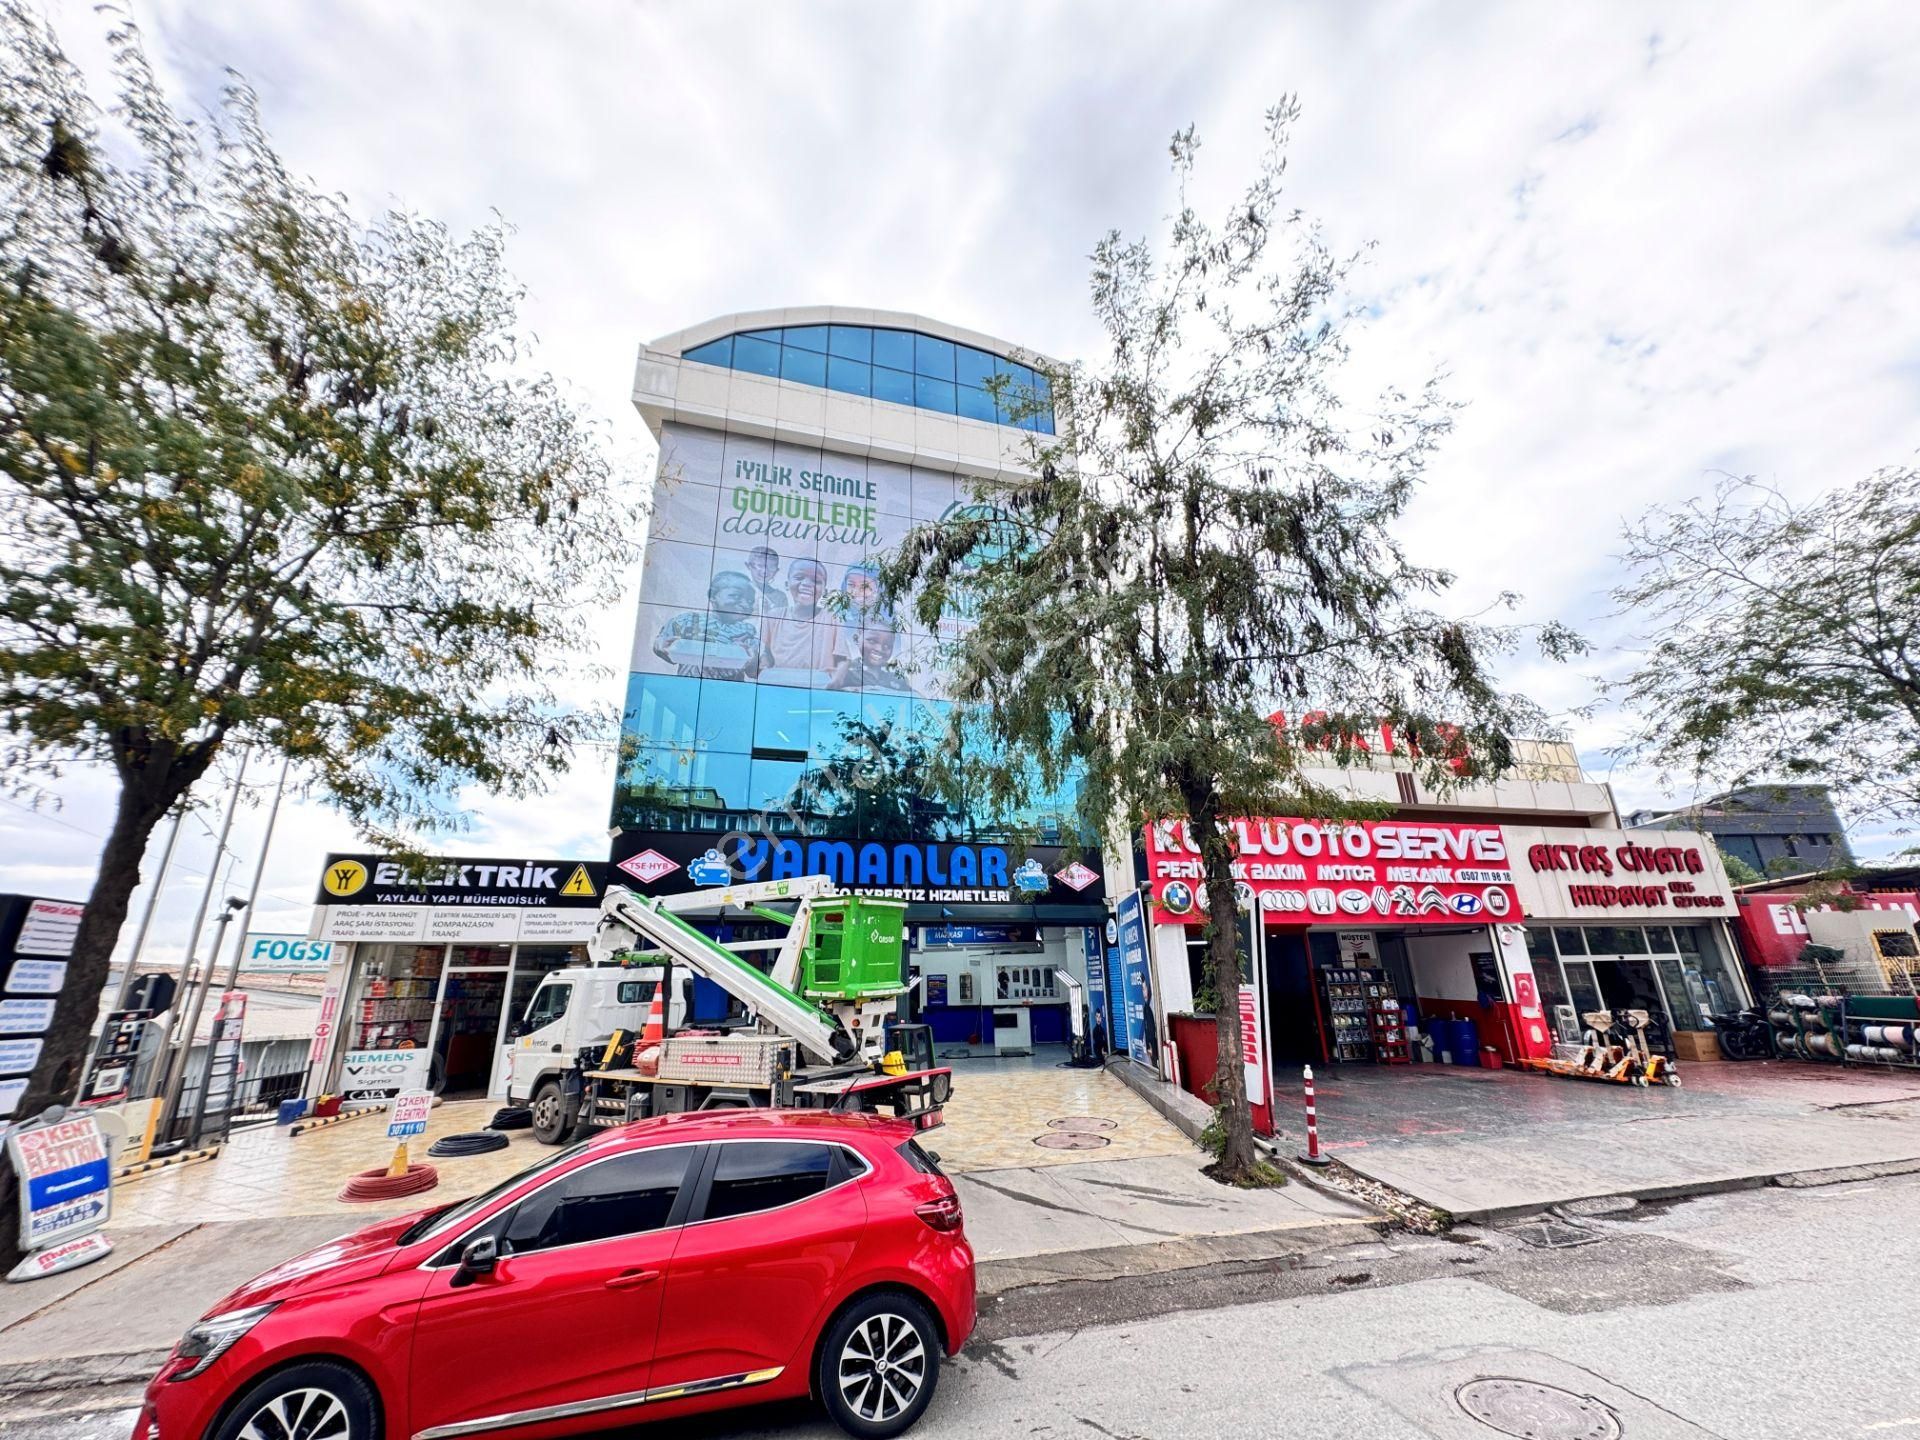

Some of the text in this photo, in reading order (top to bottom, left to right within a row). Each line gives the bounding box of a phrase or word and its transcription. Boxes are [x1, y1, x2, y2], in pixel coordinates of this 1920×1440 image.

[736, 460, 877, 501] İYİLİK SENİNLE
[733, 485, 877, 531] GÖNÜLLERE
[723, 510, 883, 547] dokunsun
[1292, 823, 1371, 858] OTO
[738, 837, 1009, 886] YAMANLAR
[1250, 863, 1305, 881] BAKIM
[1317, 864, 1376, 882] MOTOR
[1528, 841, 1704, 877] AKTAŞ CİVATA
[431, 894, 460, 904] YAPI
[349, 1089, 387, 1101] CATA
[47, 1119, 94, 1144] KENT
